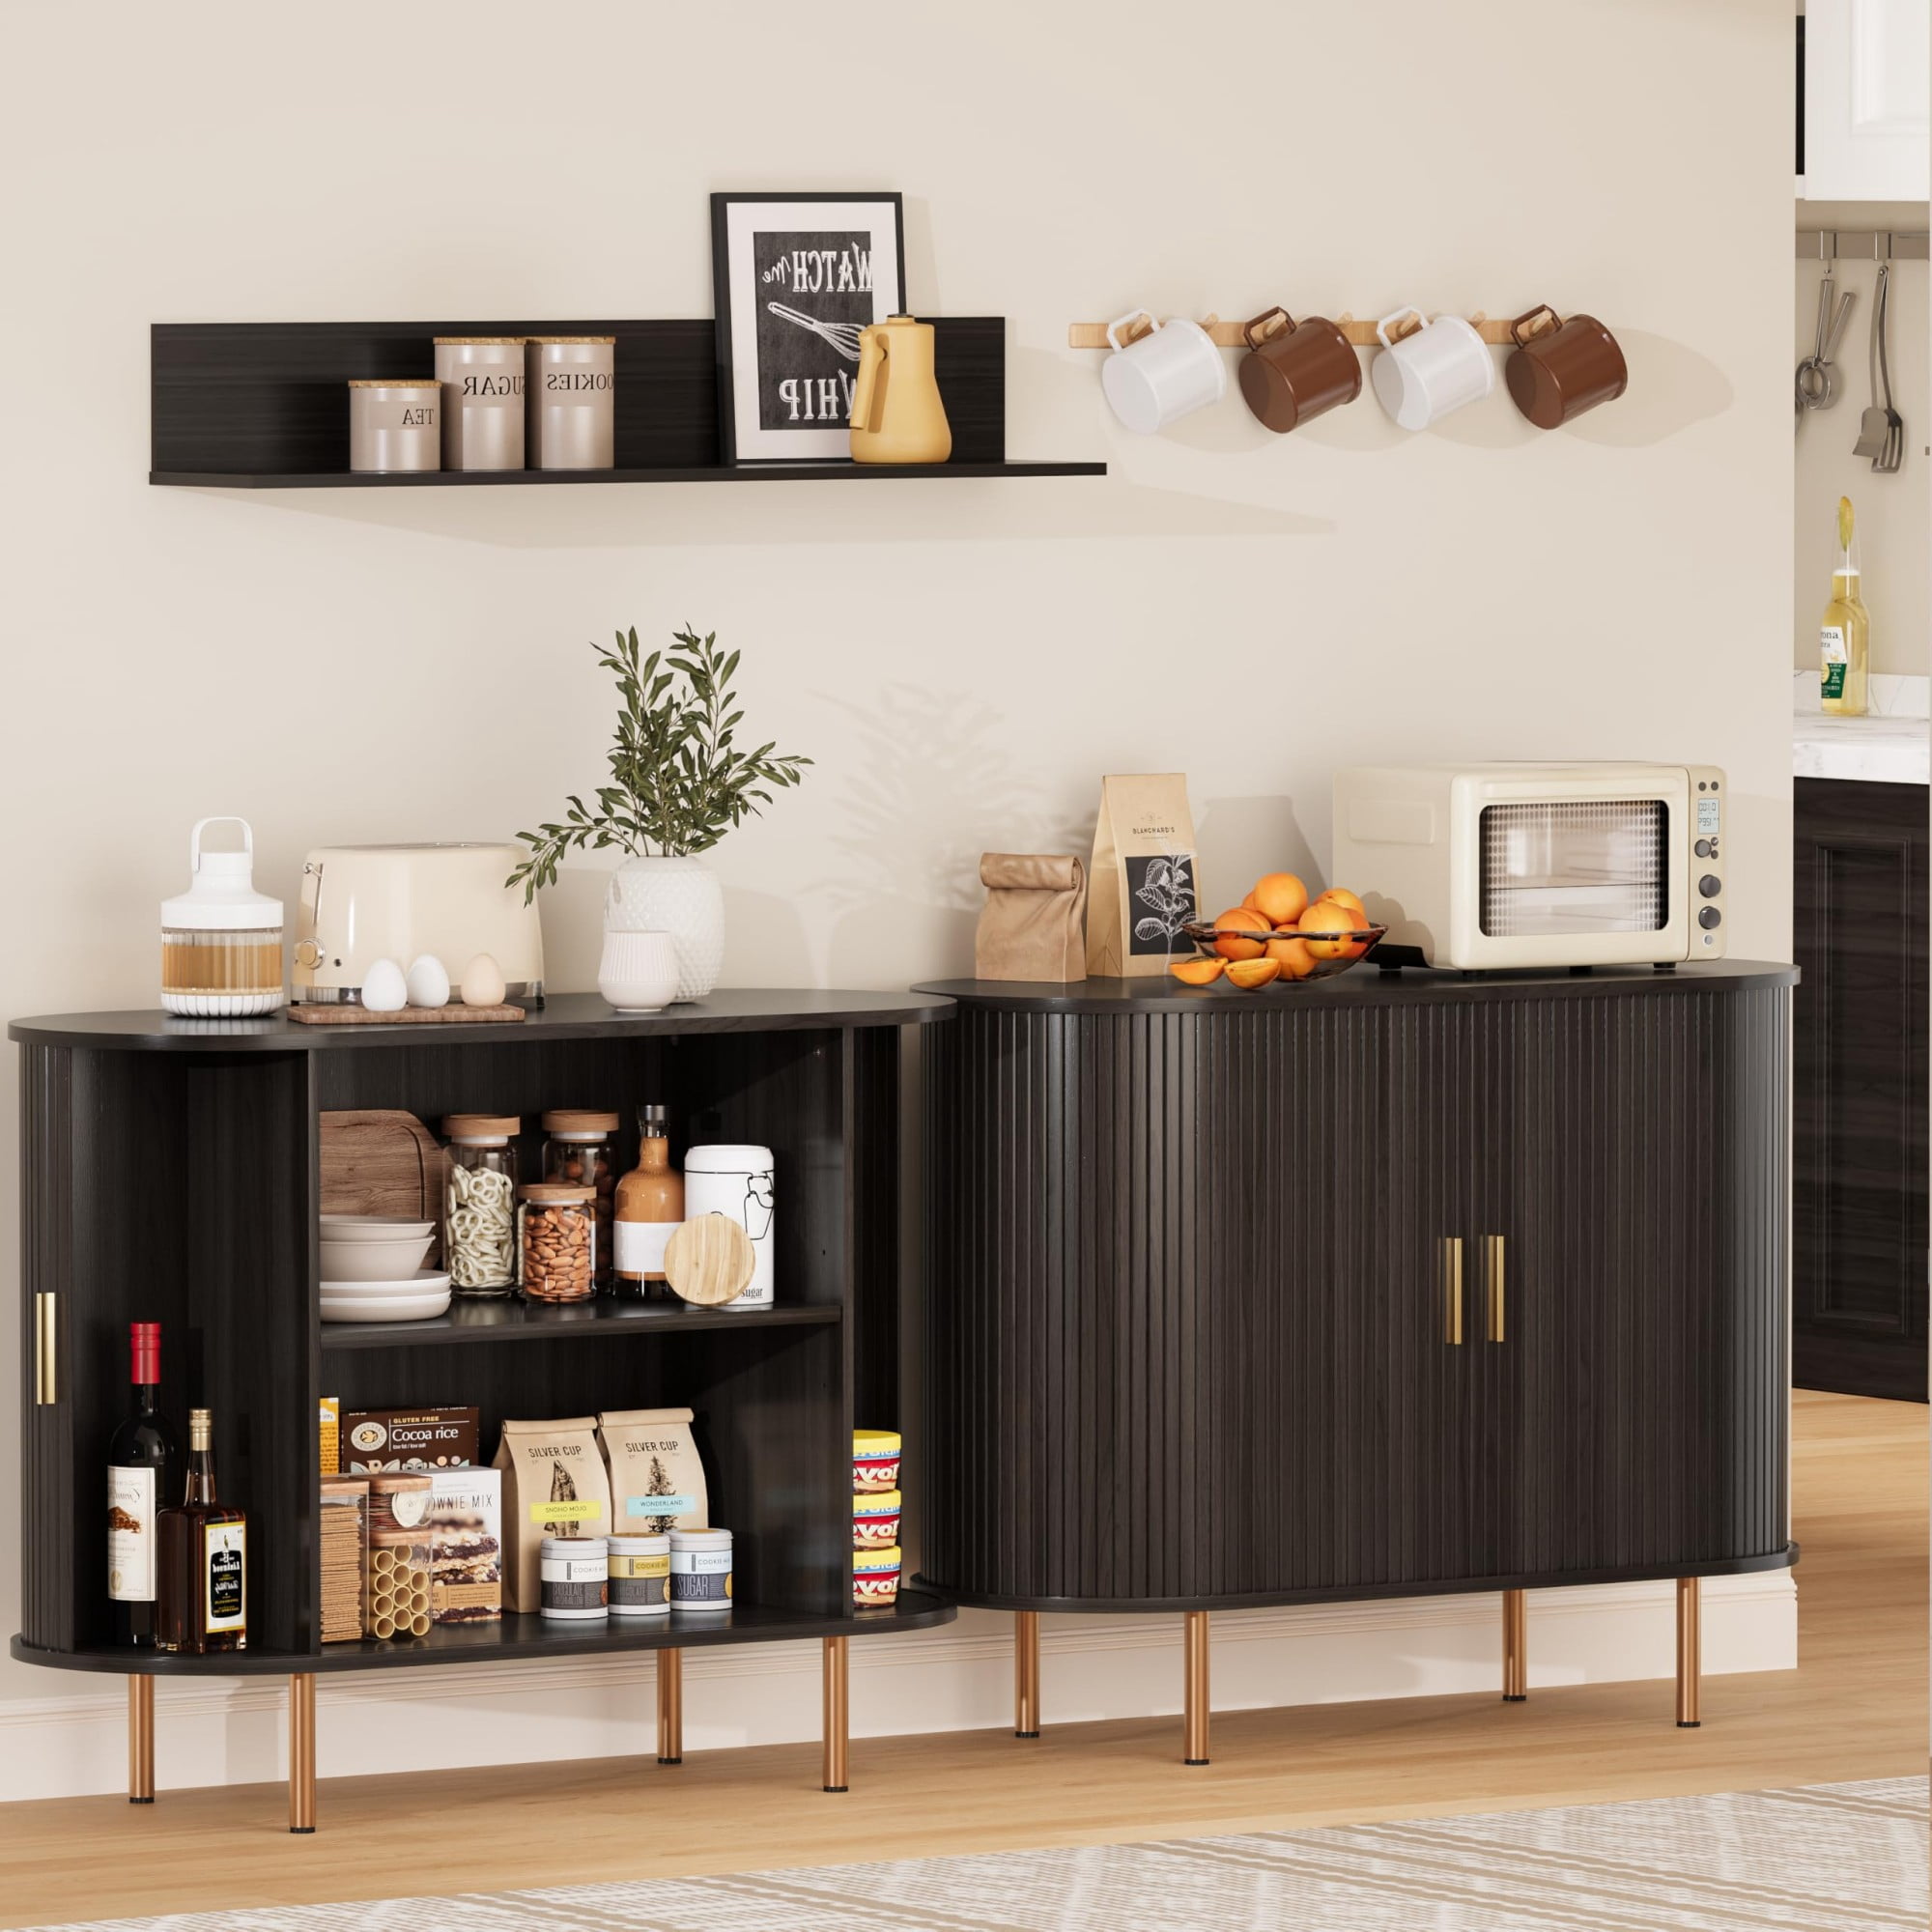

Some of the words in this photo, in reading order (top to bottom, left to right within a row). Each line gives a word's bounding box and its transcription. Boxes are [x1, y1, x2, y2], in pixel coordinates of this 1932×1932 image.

[1132, 826, 1176, 835] BLANCHARD'S
[392, 1428, 432, 1442] Cocoa
[436, 1426, 459, 1438] rice
[527, 1446, 561, 1458] SILVER
[562, 1445, 582, 1456] CUP
[625, 1441, 658, 1453] SILVER
[659, 1440, 679, 1451] CUP
[471, 1493, 493, 1508] MIX
[677, 1576, 709, 1597] SUGAR
